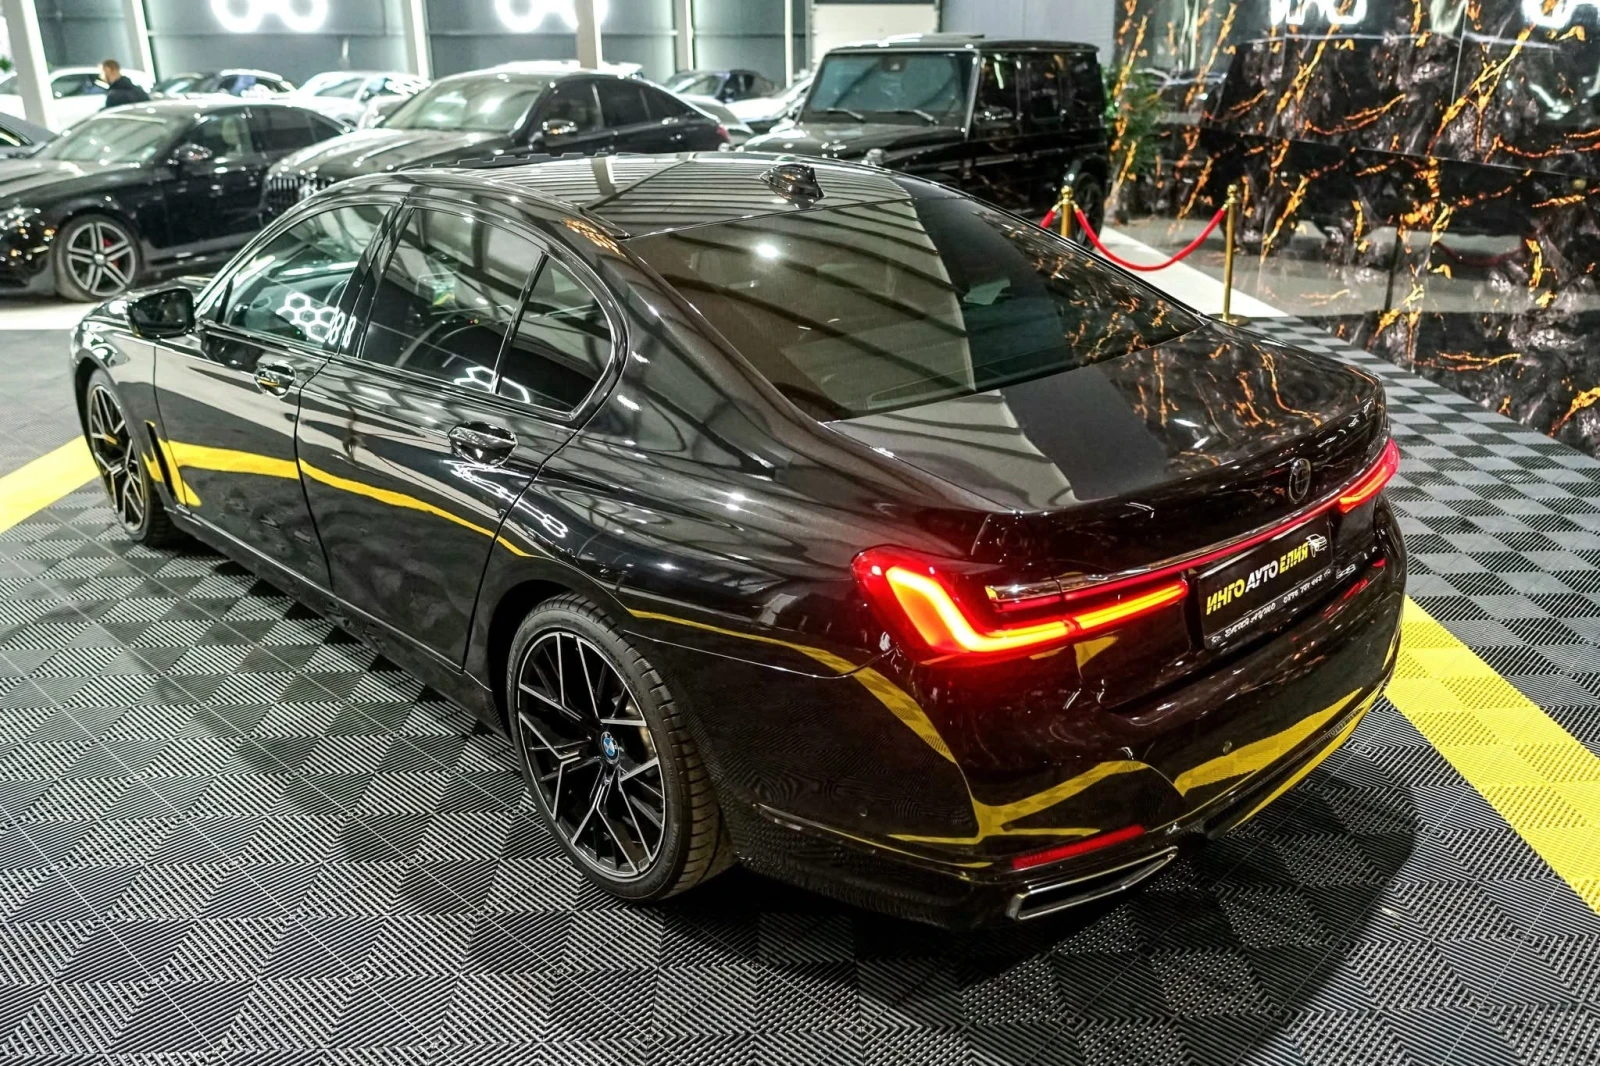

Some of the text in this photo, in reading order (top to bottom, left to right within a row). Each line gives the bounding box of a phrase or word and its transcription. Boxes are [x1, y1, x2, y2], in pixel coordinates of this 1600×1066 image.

[1206, 579, 1245, 615] ИНГО
[1245, 560, 1279, 593] АУТО
[1279, 541, 1309, 574] ЕЛИЯ
